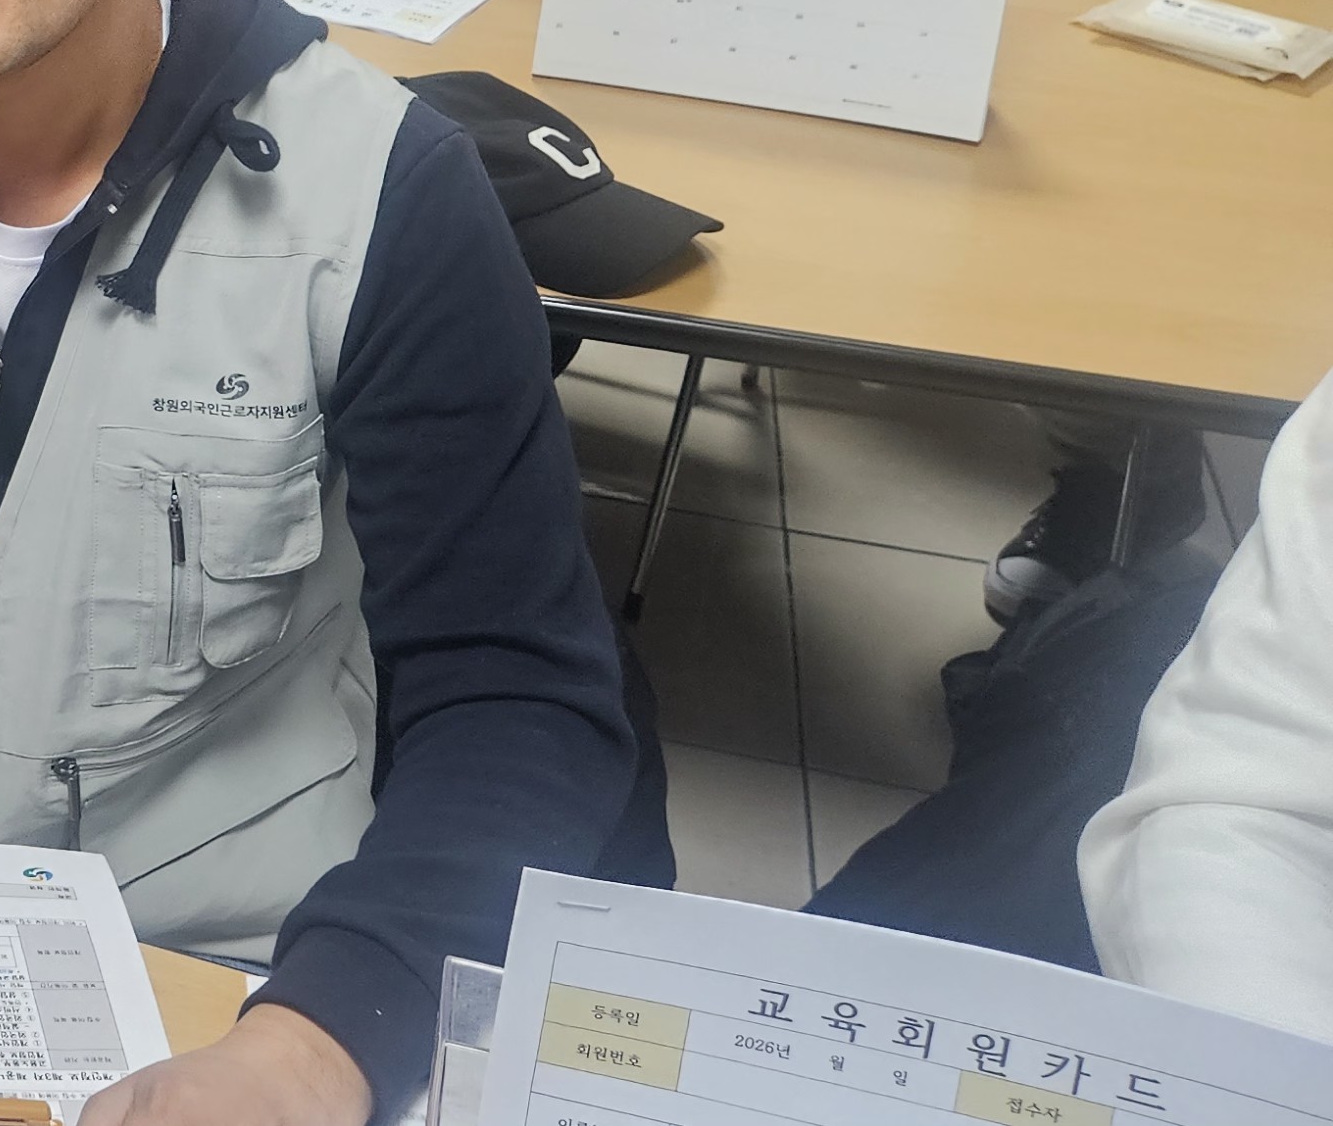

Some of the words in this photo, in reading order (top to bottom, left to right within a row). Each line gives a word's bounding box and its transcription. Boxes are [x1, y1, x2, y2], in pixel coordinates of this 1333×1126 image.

[528, 126, 601, 180] C
[152, 397, 309, 420] 창원외국인근로자지원센터
[591, 1004, 640, 1027] 등록일
[576, 1043, 642, 1069] 회원번호
[734, 1034, 791, 1060] 2026년
[828, 1054, 845, 1072] 월
[892, 1069, 908, 1087] 일
[33, 1072, 62, 1081] 제3자
[70, 1072, 113, 1081] 개인정보
[1006, 1096, 1063, 1124] 접수자
